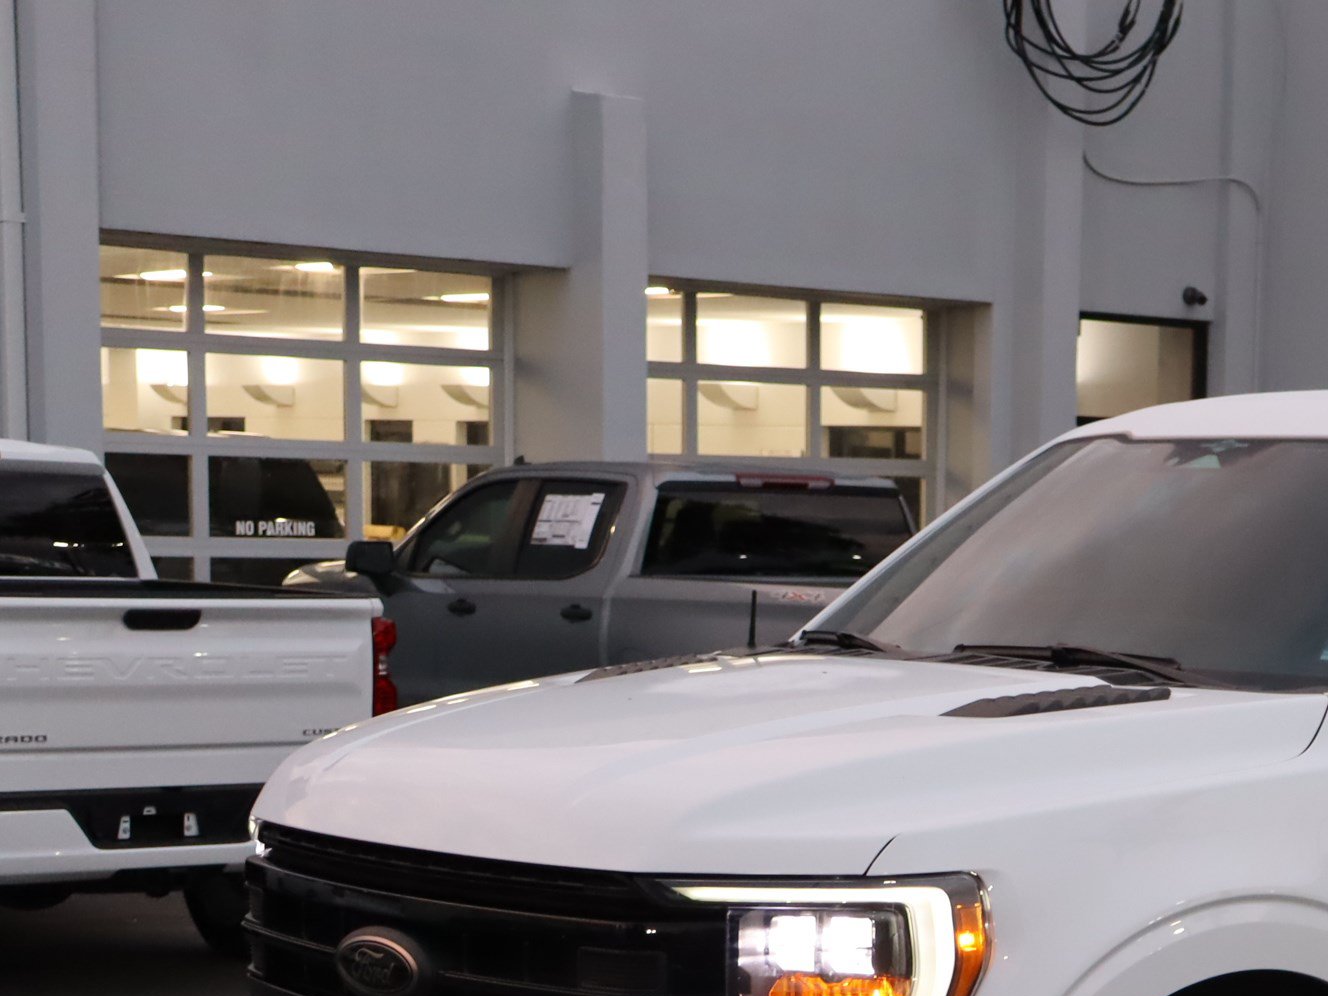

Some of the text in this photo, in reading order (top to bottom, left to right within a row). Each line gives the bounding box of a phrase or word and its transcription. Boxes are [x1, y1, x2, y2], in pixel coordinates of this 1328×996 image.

[235, 520, 316, 537] NO PARKING
[0, 734, 48, 743] ADO
